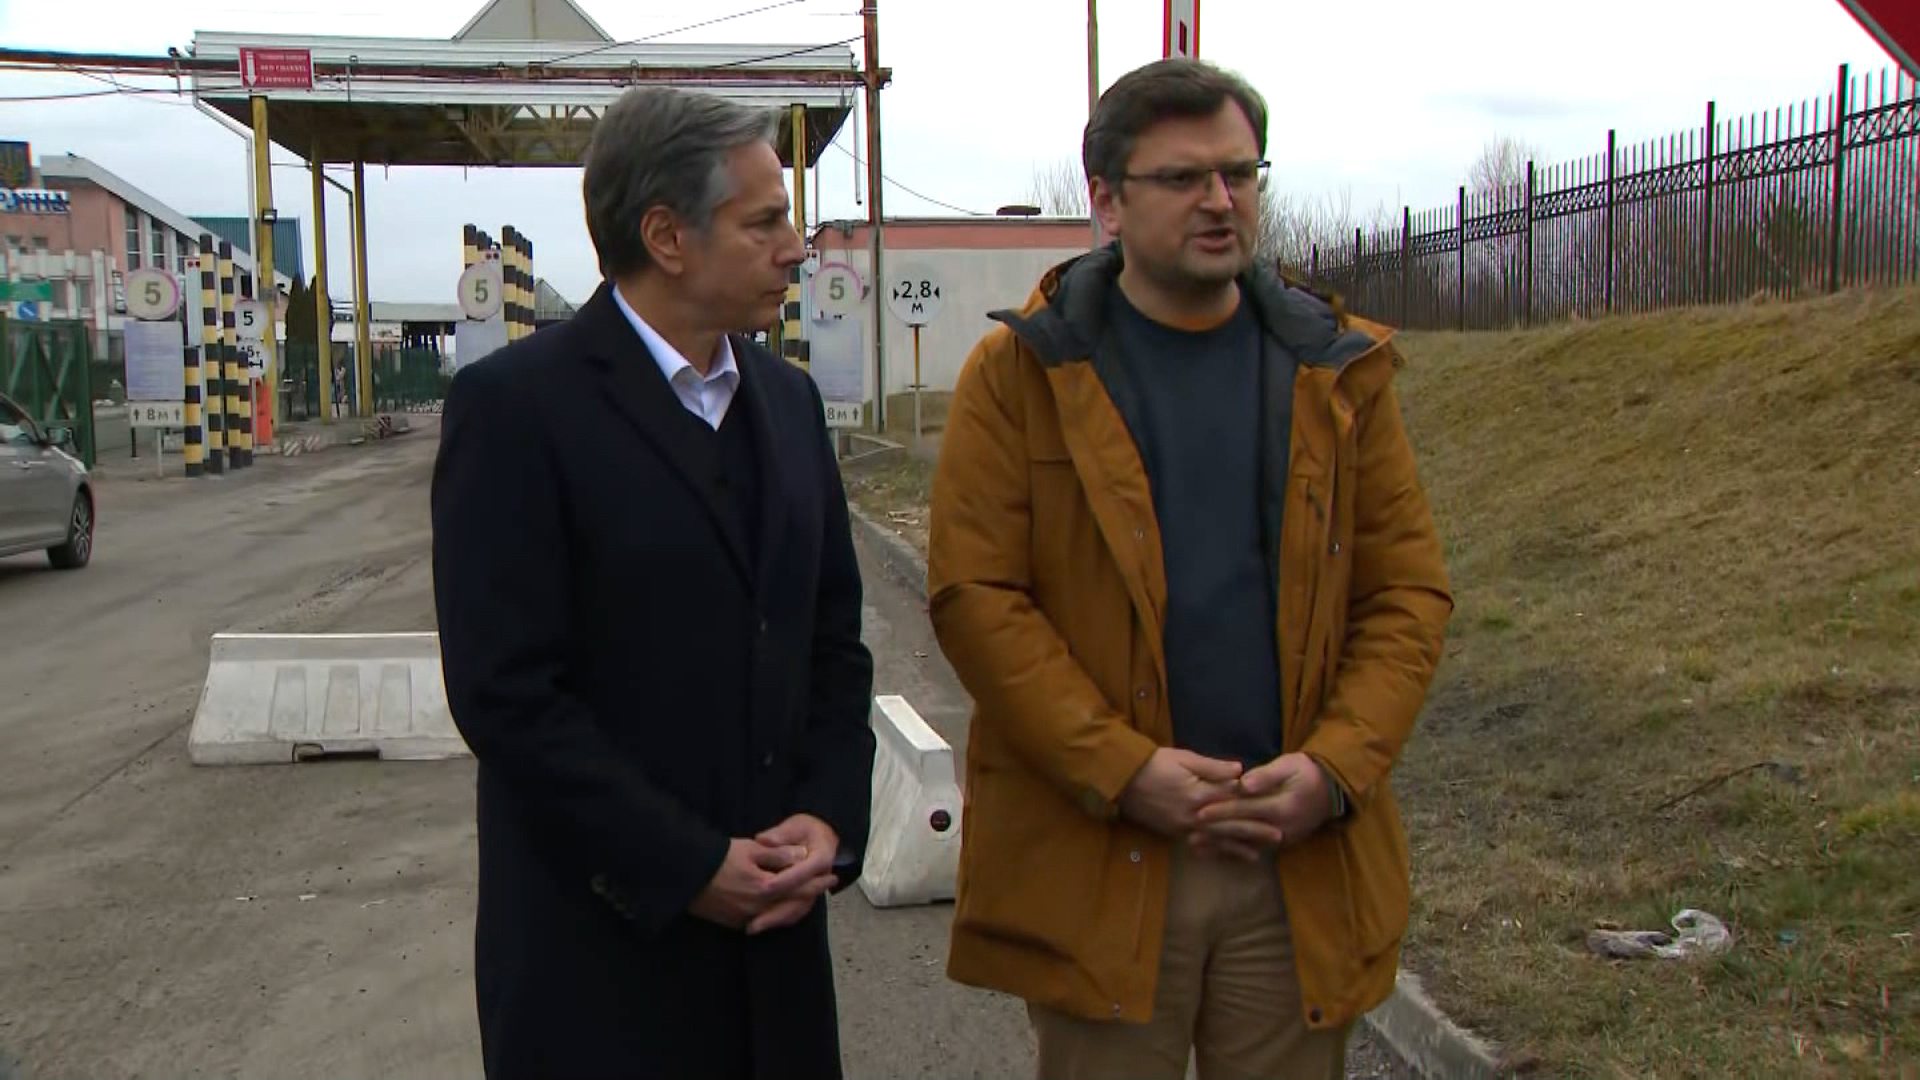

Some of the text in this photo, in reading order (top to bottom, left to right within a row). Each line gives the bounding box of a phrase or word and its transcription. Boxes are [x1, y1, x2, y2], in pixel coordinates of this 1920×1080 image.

[144, 281, 161, 306] 5
[475, 279, 489, 304] 5
[829, 277, 845, 300] 5
[243, 311, 254, 326] 5
